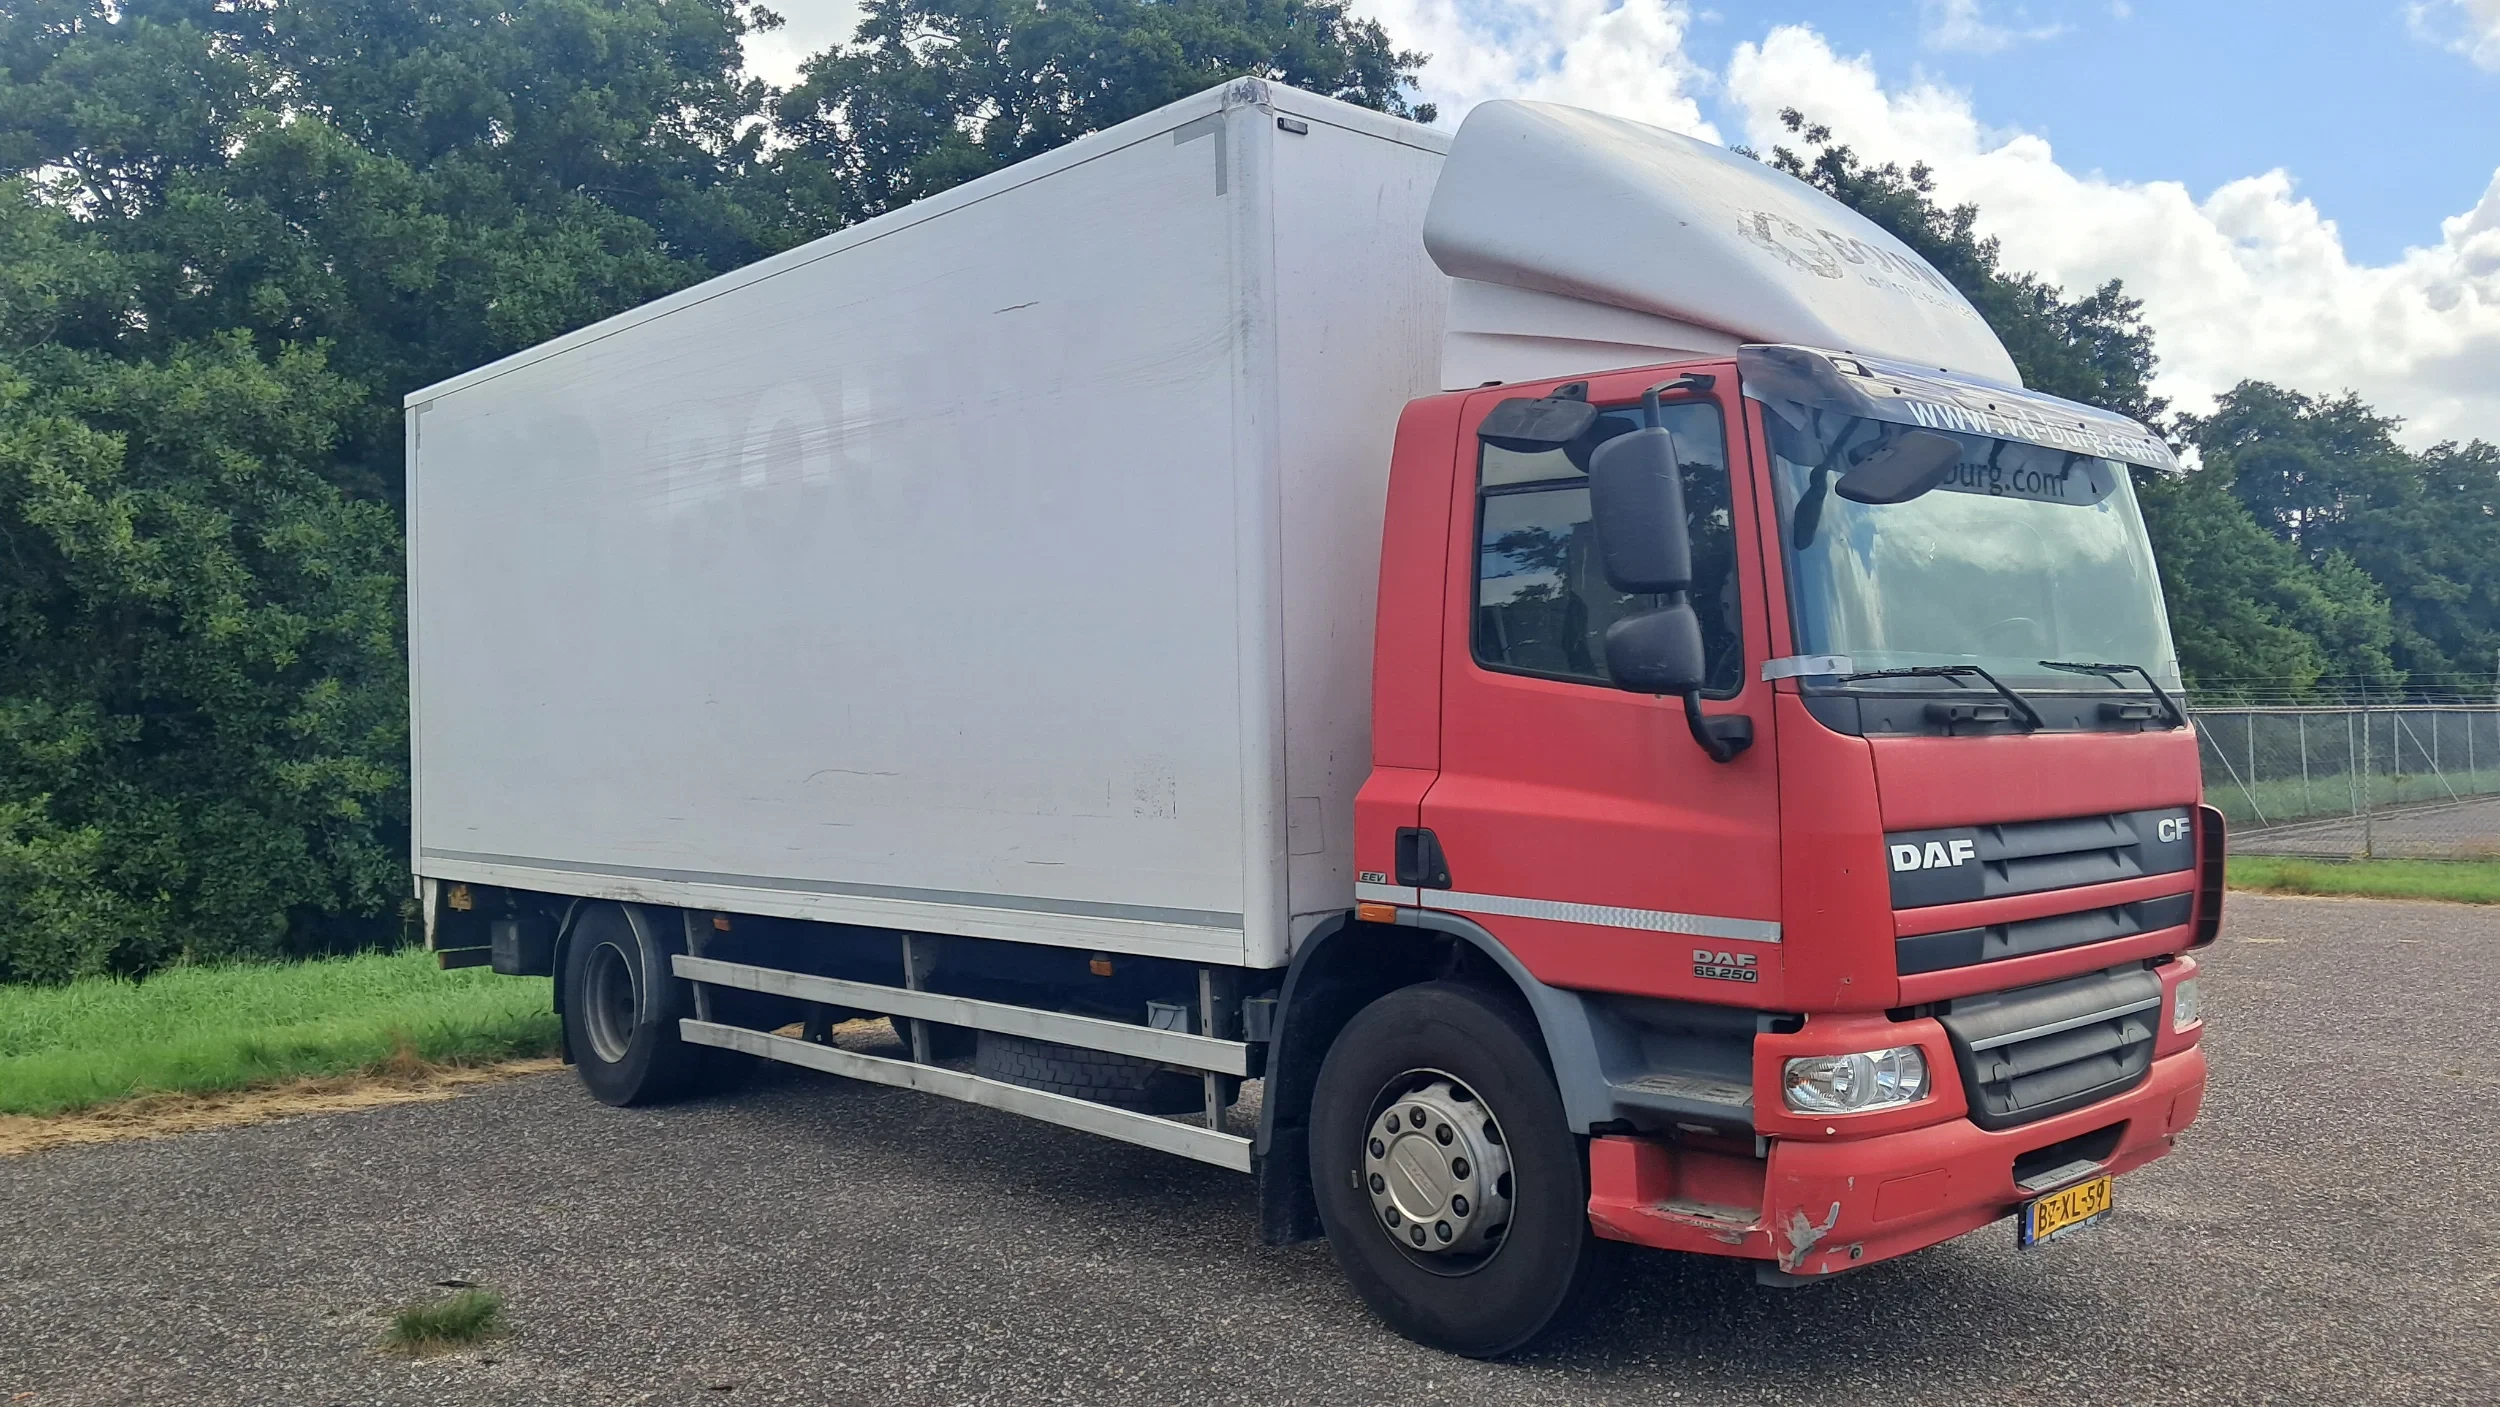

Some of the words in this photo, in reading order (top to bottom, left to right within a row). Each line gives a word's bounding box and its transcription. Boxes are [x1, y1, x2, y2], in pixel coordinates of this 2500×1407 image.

[1905, 400, 2161, 463] www.vd-burg.com
[2157, 817, 2191, 843] CF
[1889, 839, 1976, 872] DAF
[1361, 872, 1385, 882] EEV
[1692, 949, 1757, 967] DAF
[1694, 965, 1756, 981] 65.250
[2039, 1179, 2105, 1233] BZ-XL-59
